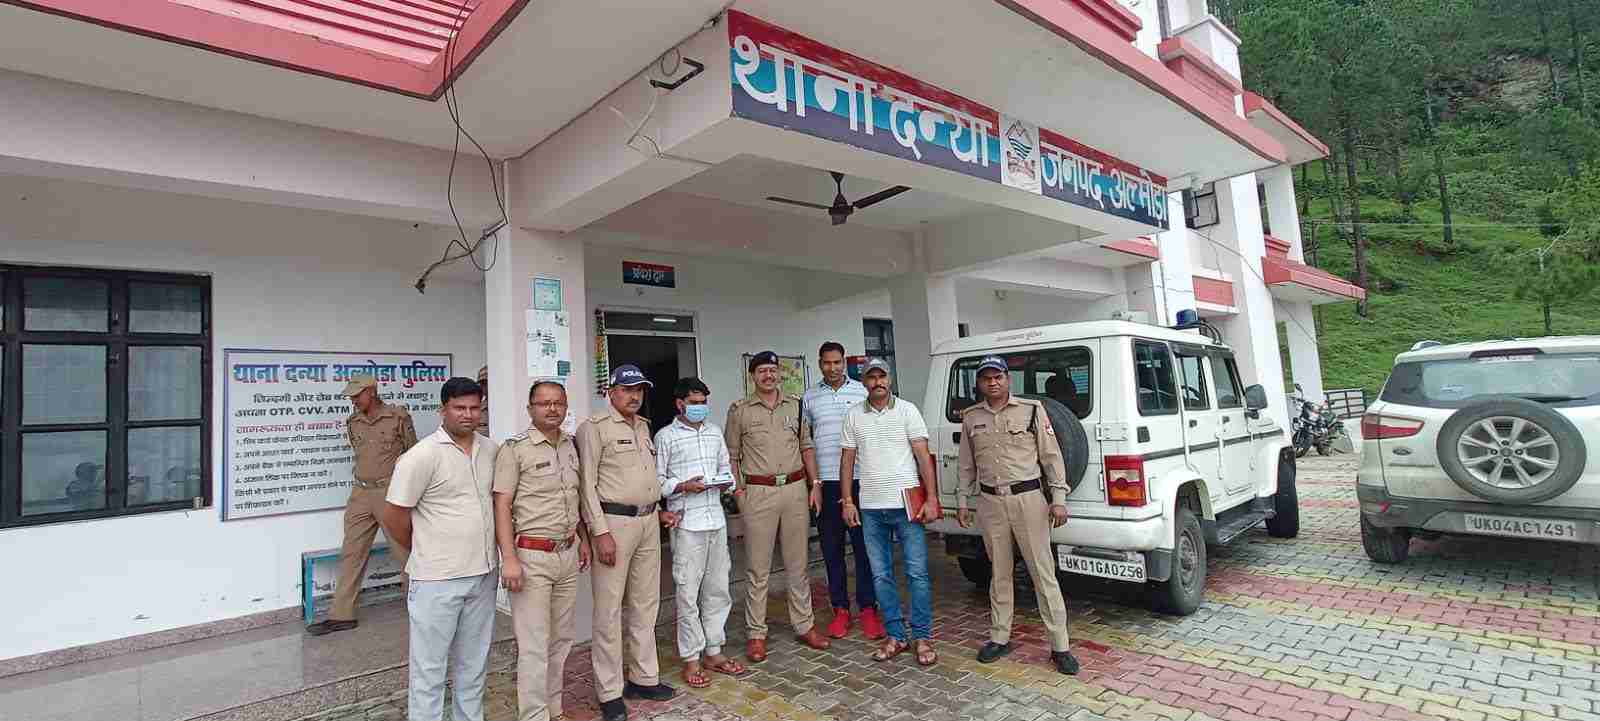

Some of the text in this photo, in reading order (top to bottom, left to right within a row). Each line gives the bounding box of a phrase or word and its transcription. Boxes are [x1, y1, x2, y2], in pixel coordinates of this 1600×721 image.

[733, 35, 876, 137] थाना
[877, 84, 996, 167] दन्या
[1040, 141, 1105, 209] जनपद
[233, 364, 280, 383] थाना
[283, 364, 328, 383] दन्या
[399, 360, 447, 388] पुलिस
[327, 405, 350, 414] ATM
[1473, 516, 1575, 537] UK04AC1491
